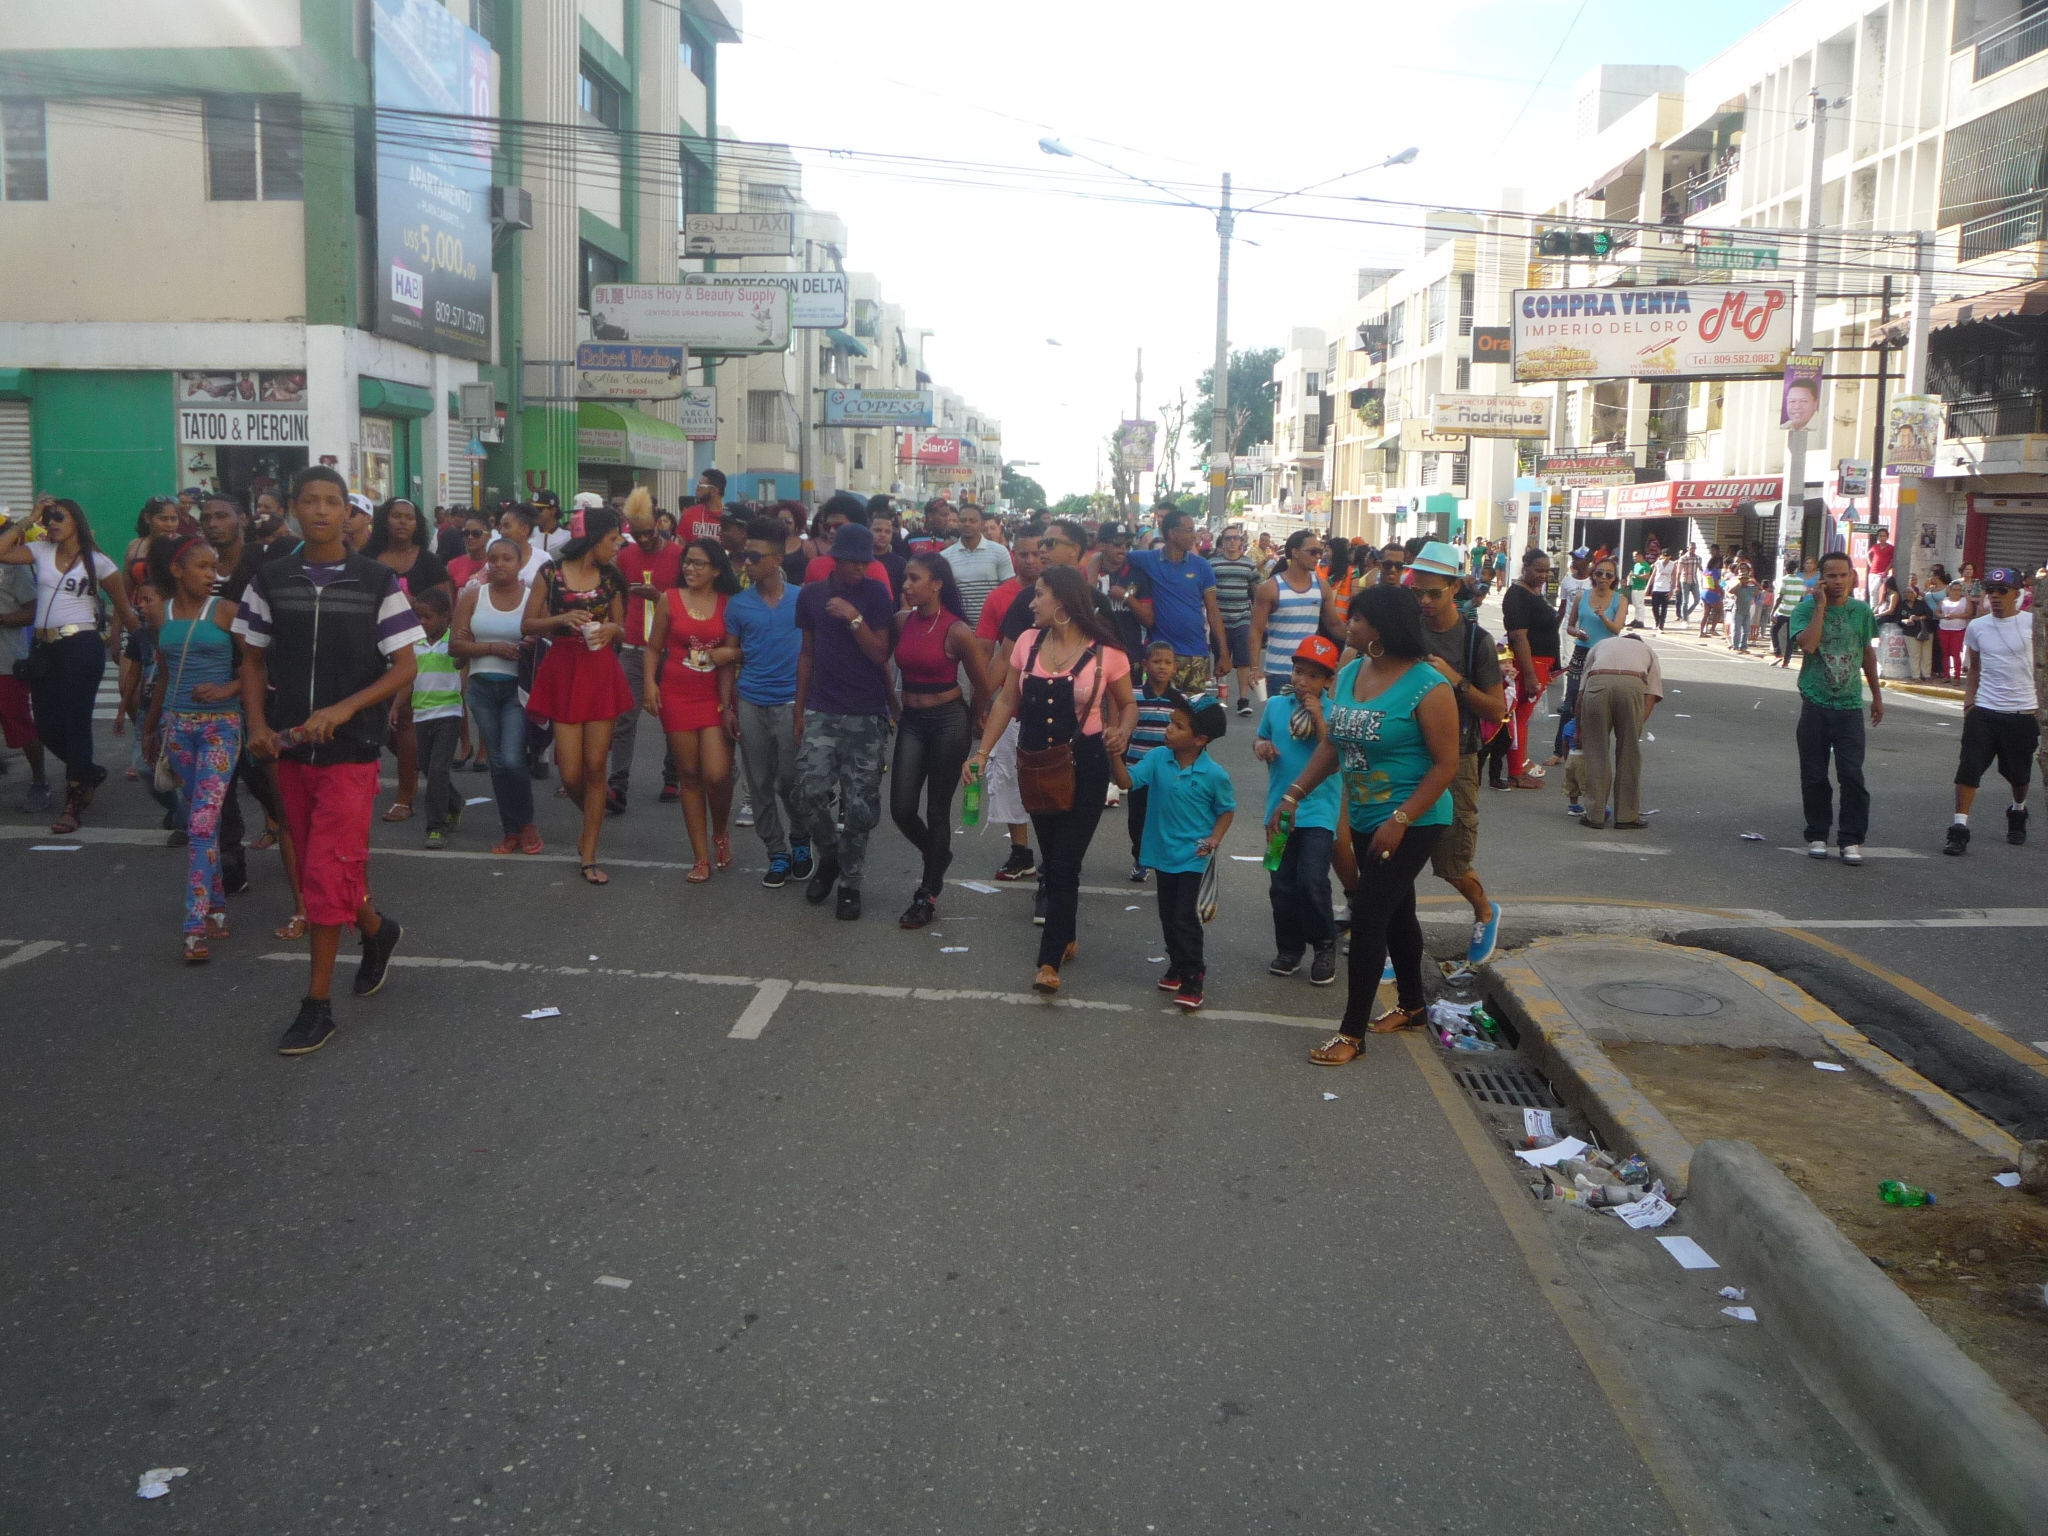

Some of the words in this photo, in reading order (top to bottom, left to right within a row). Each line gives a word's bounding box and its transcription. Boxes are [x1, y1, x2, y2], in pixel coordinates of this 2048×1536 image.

[750, 215, 788, 231] TAXI
[1699, 249, 1724, 267] SAN
[1727, 250, 1754, 268] LUIS
[395, 271, 422, 304] HABI
[802, 278, 844, 294] DELTA
[626, 286, 653, 300] Uñas
[657, 287, 682, 304] Holy
[685, 287, 693, 300] &
[696, 288, 735, 305] Beauty
[738, 288, 776, 305] Supply
[1522, 293, 1617, 319] COMPRA
[1620, 290, 1692, 316] VENTA
[1525, 322, 1603, 337] IMPERIO
[1610, 321, 1643, 334] DEL
[1650, 320, 1688, 333] ORO
[1714, 353, 1775, 365] 809.582.0882
[1787, 355, 1824, 367] MONCHY
[843, 400, 925, 414] COPESA
[182, 412, 227, 440] TATOO
[232, 416, 242, 440] &
[680, 417, 715, 425] TRAVEL
[920, 441, 949, 454] Claro
[1546, 458, 1626, 470] MANUEL
[1895, 464, 1926, 475] MONCHY
[1676, 483, 1697, 497] EL
[1702, 482, 1777, 497] CUBANO
